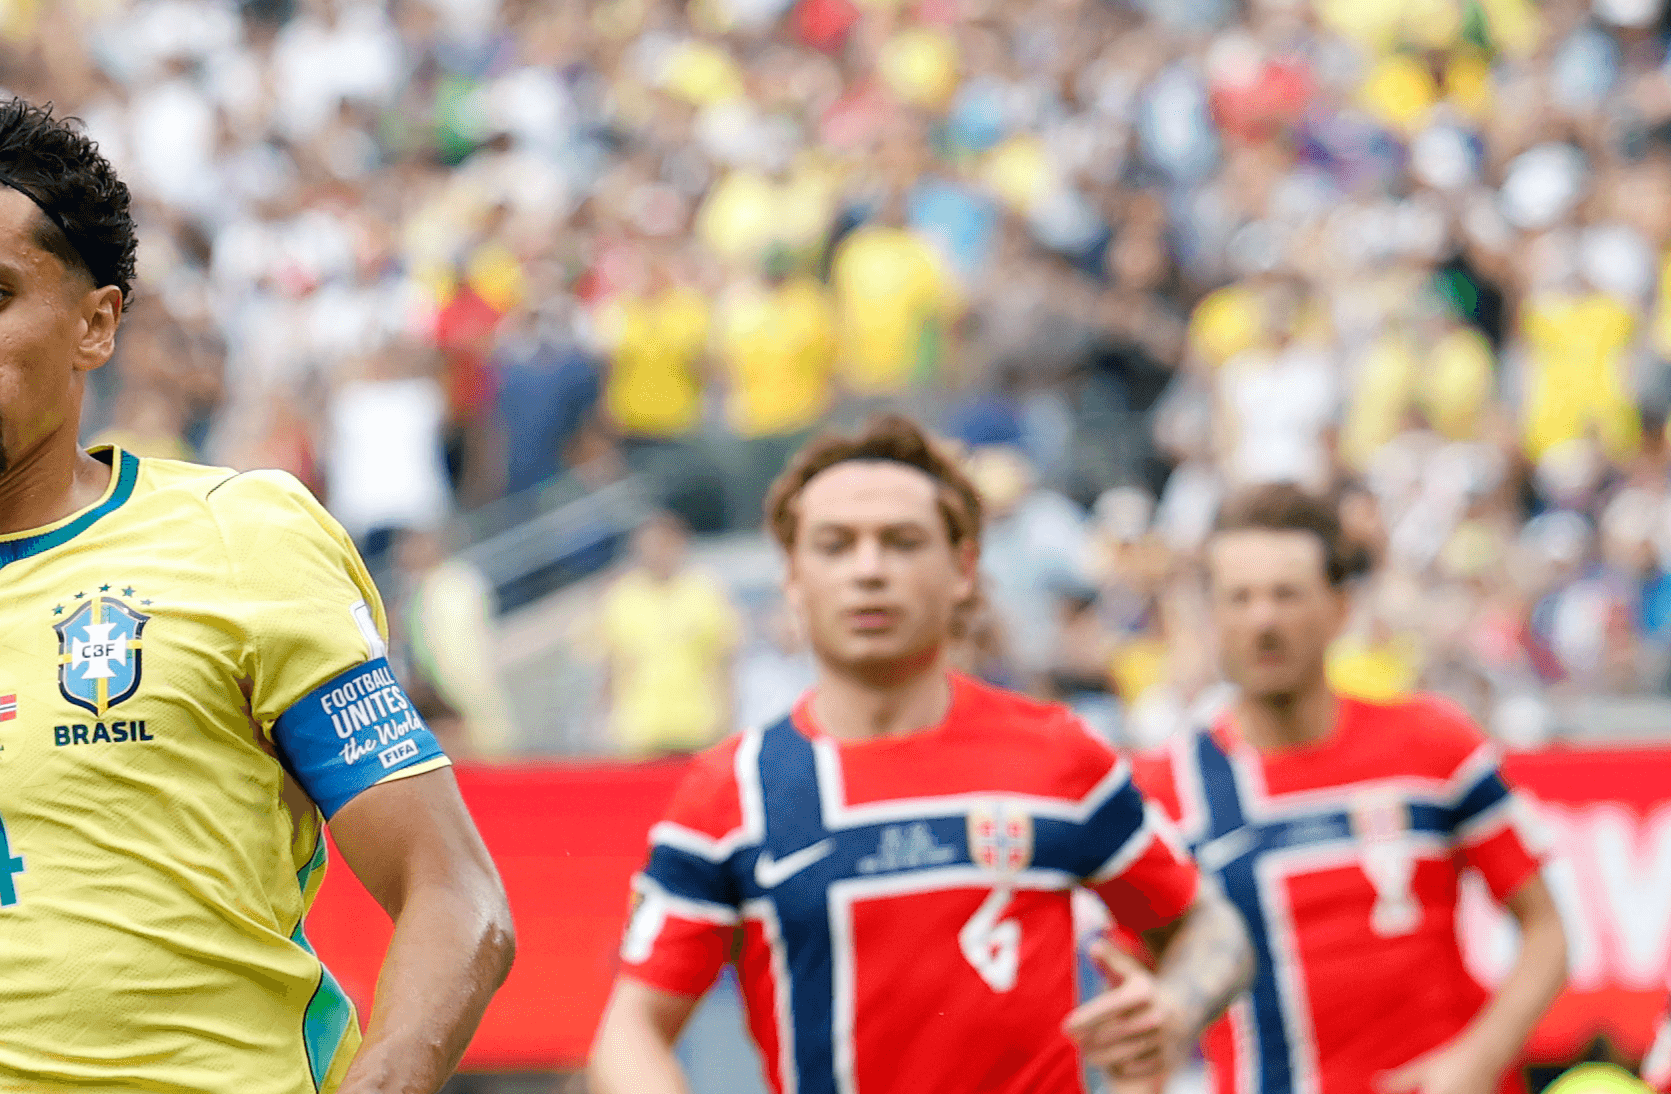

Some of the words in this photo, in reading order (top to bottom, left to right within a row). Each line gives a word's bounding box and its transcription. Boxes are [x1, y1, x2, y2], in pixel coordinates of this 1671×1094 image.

[81, 643, 116, 659] CBF
[320, 666, 395, 715] FOOTBALL
[331, 685, 410, 739] UNITES
[54, 720, 155, 747] BRASIL
[338, 737, 377, 766] the
[374, 711, 426, 746] World
[382, 742, 417, 765] FIFA
[959, 882, 1023, 993] 6
